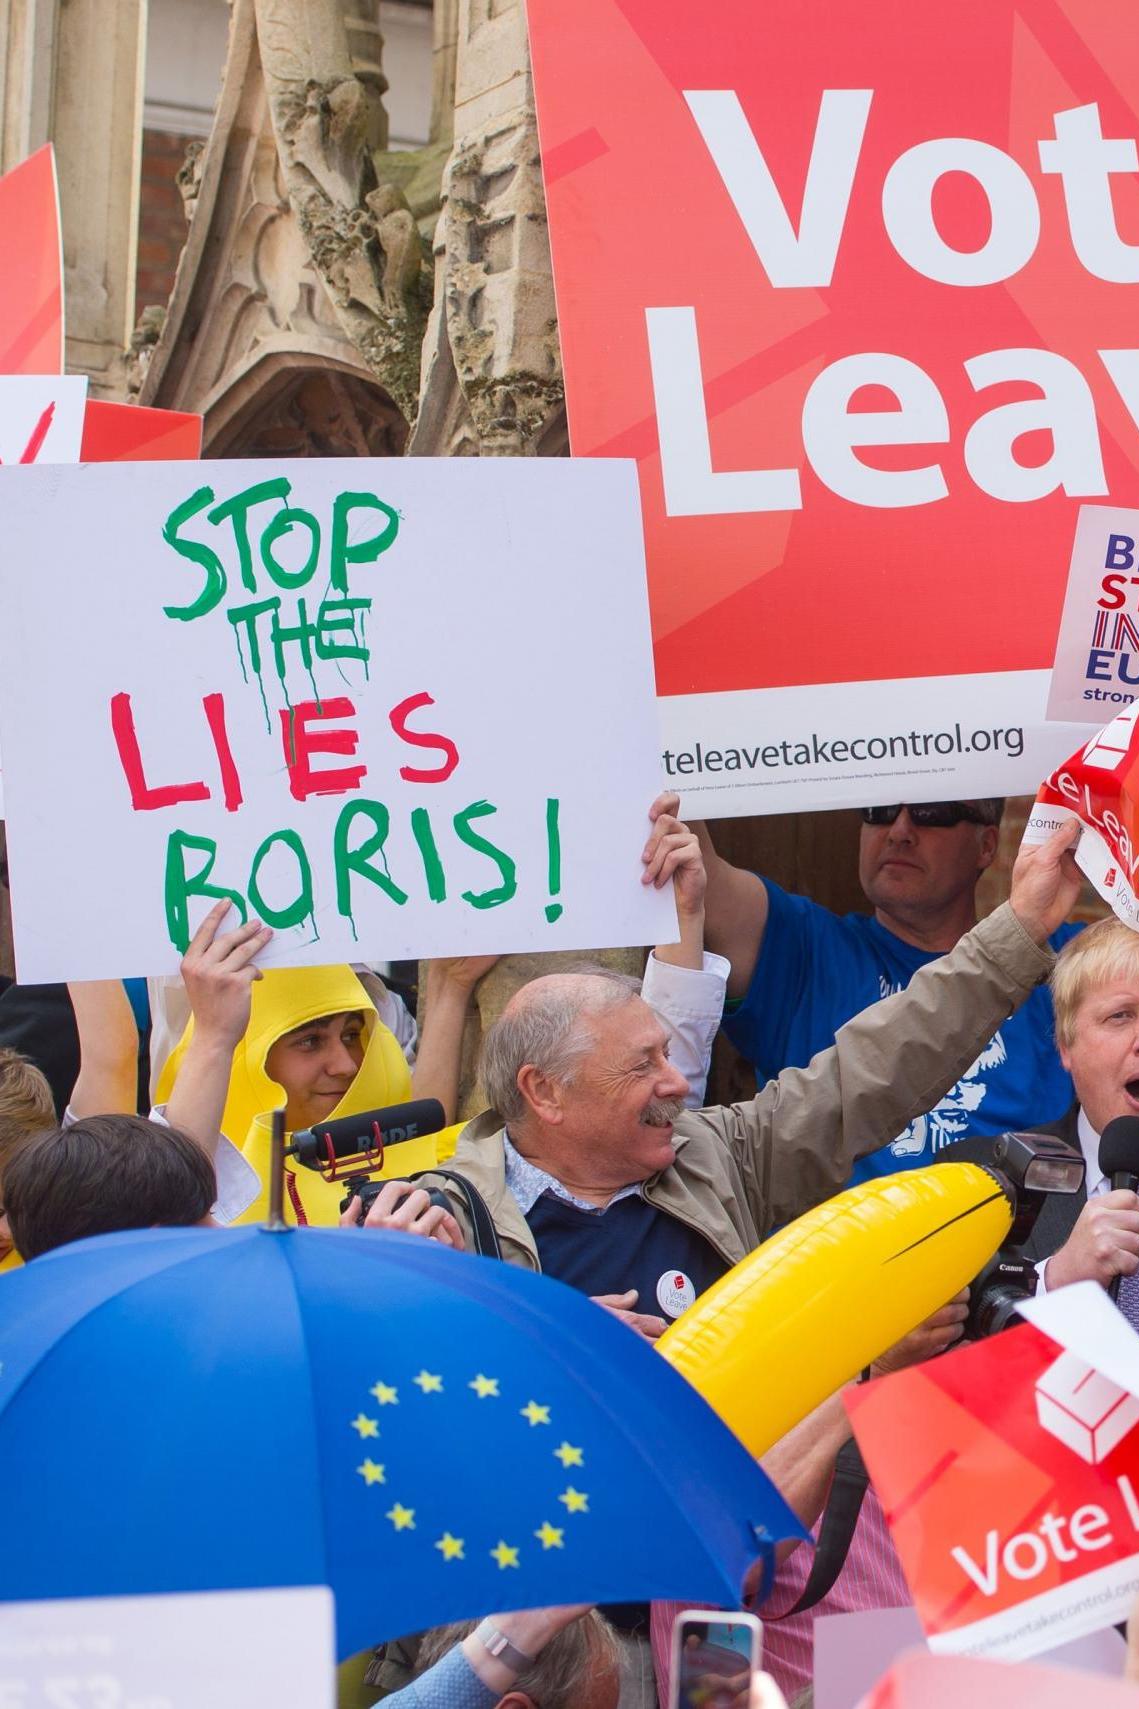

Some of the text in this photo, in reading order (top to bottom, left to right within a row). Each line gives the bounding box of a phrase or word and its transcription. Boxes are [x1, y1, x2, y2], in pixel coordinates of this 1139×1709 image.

[161, 476, 403, 622] STOP
[227, 597, 372, 680] THE
[110, 691, 459, 812] LIES
[164, 797, 564, 956] BORIS!
[999, 1263, 1024, 1272] Canon
[951, 1504, 1113, 1597] Vote
